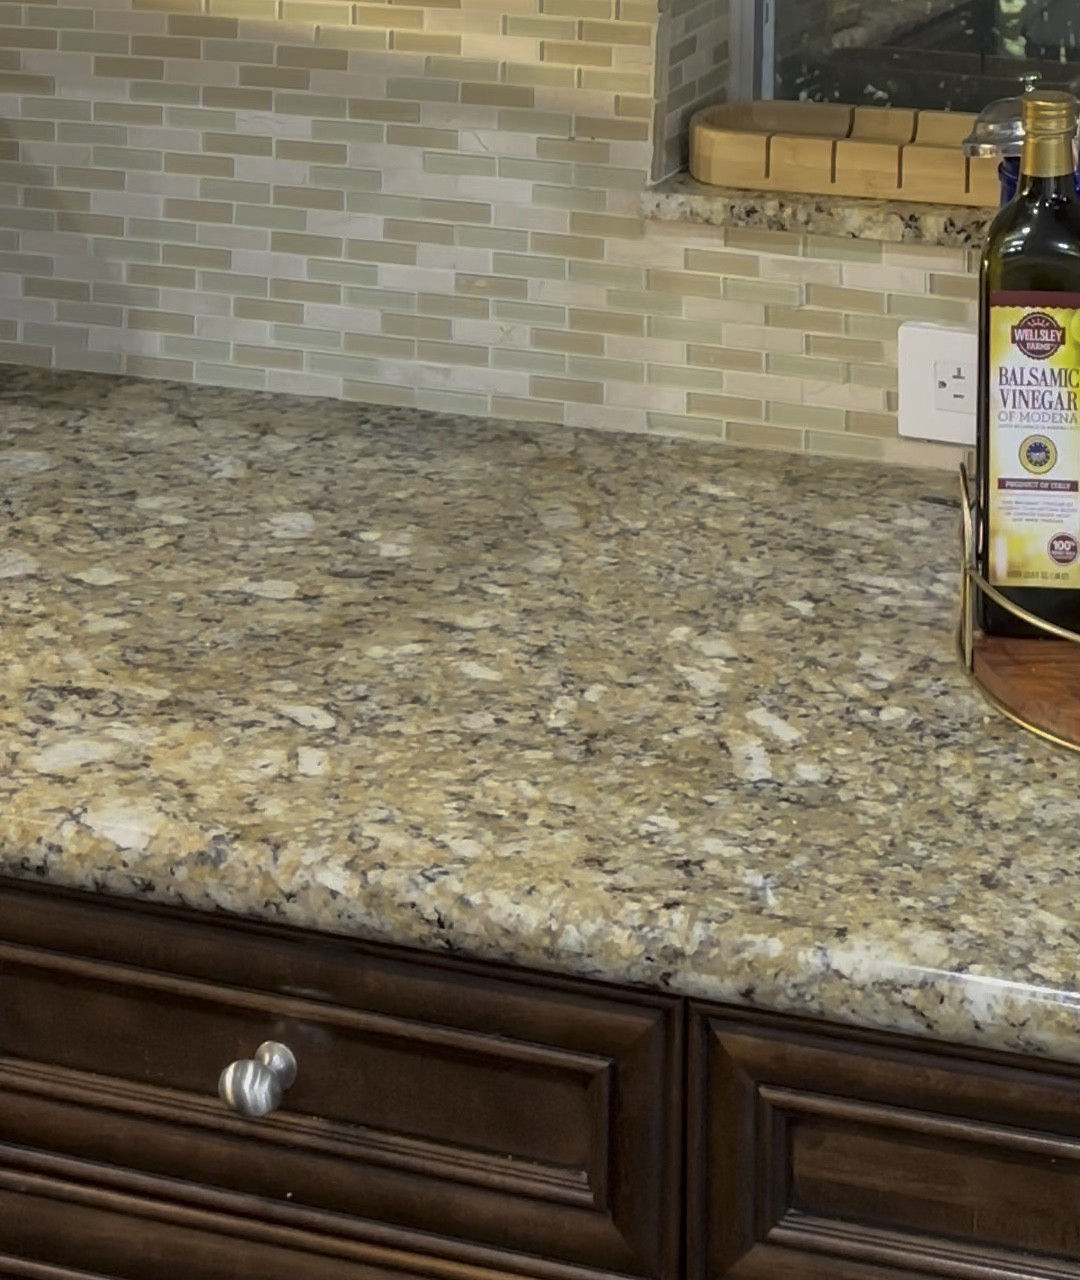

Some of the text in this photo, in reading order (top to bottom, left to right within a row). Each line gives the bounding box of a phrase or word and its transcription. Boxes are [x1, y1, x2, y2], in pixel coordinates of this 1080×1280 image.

[1014, 329, 1063, 342] WELLSLEY
[998, 366, 1080, 388] BALSAMIC
[999, 389, 1078, 411] VINEGAR
[997, 410, 1078, 424] OF MODENA
